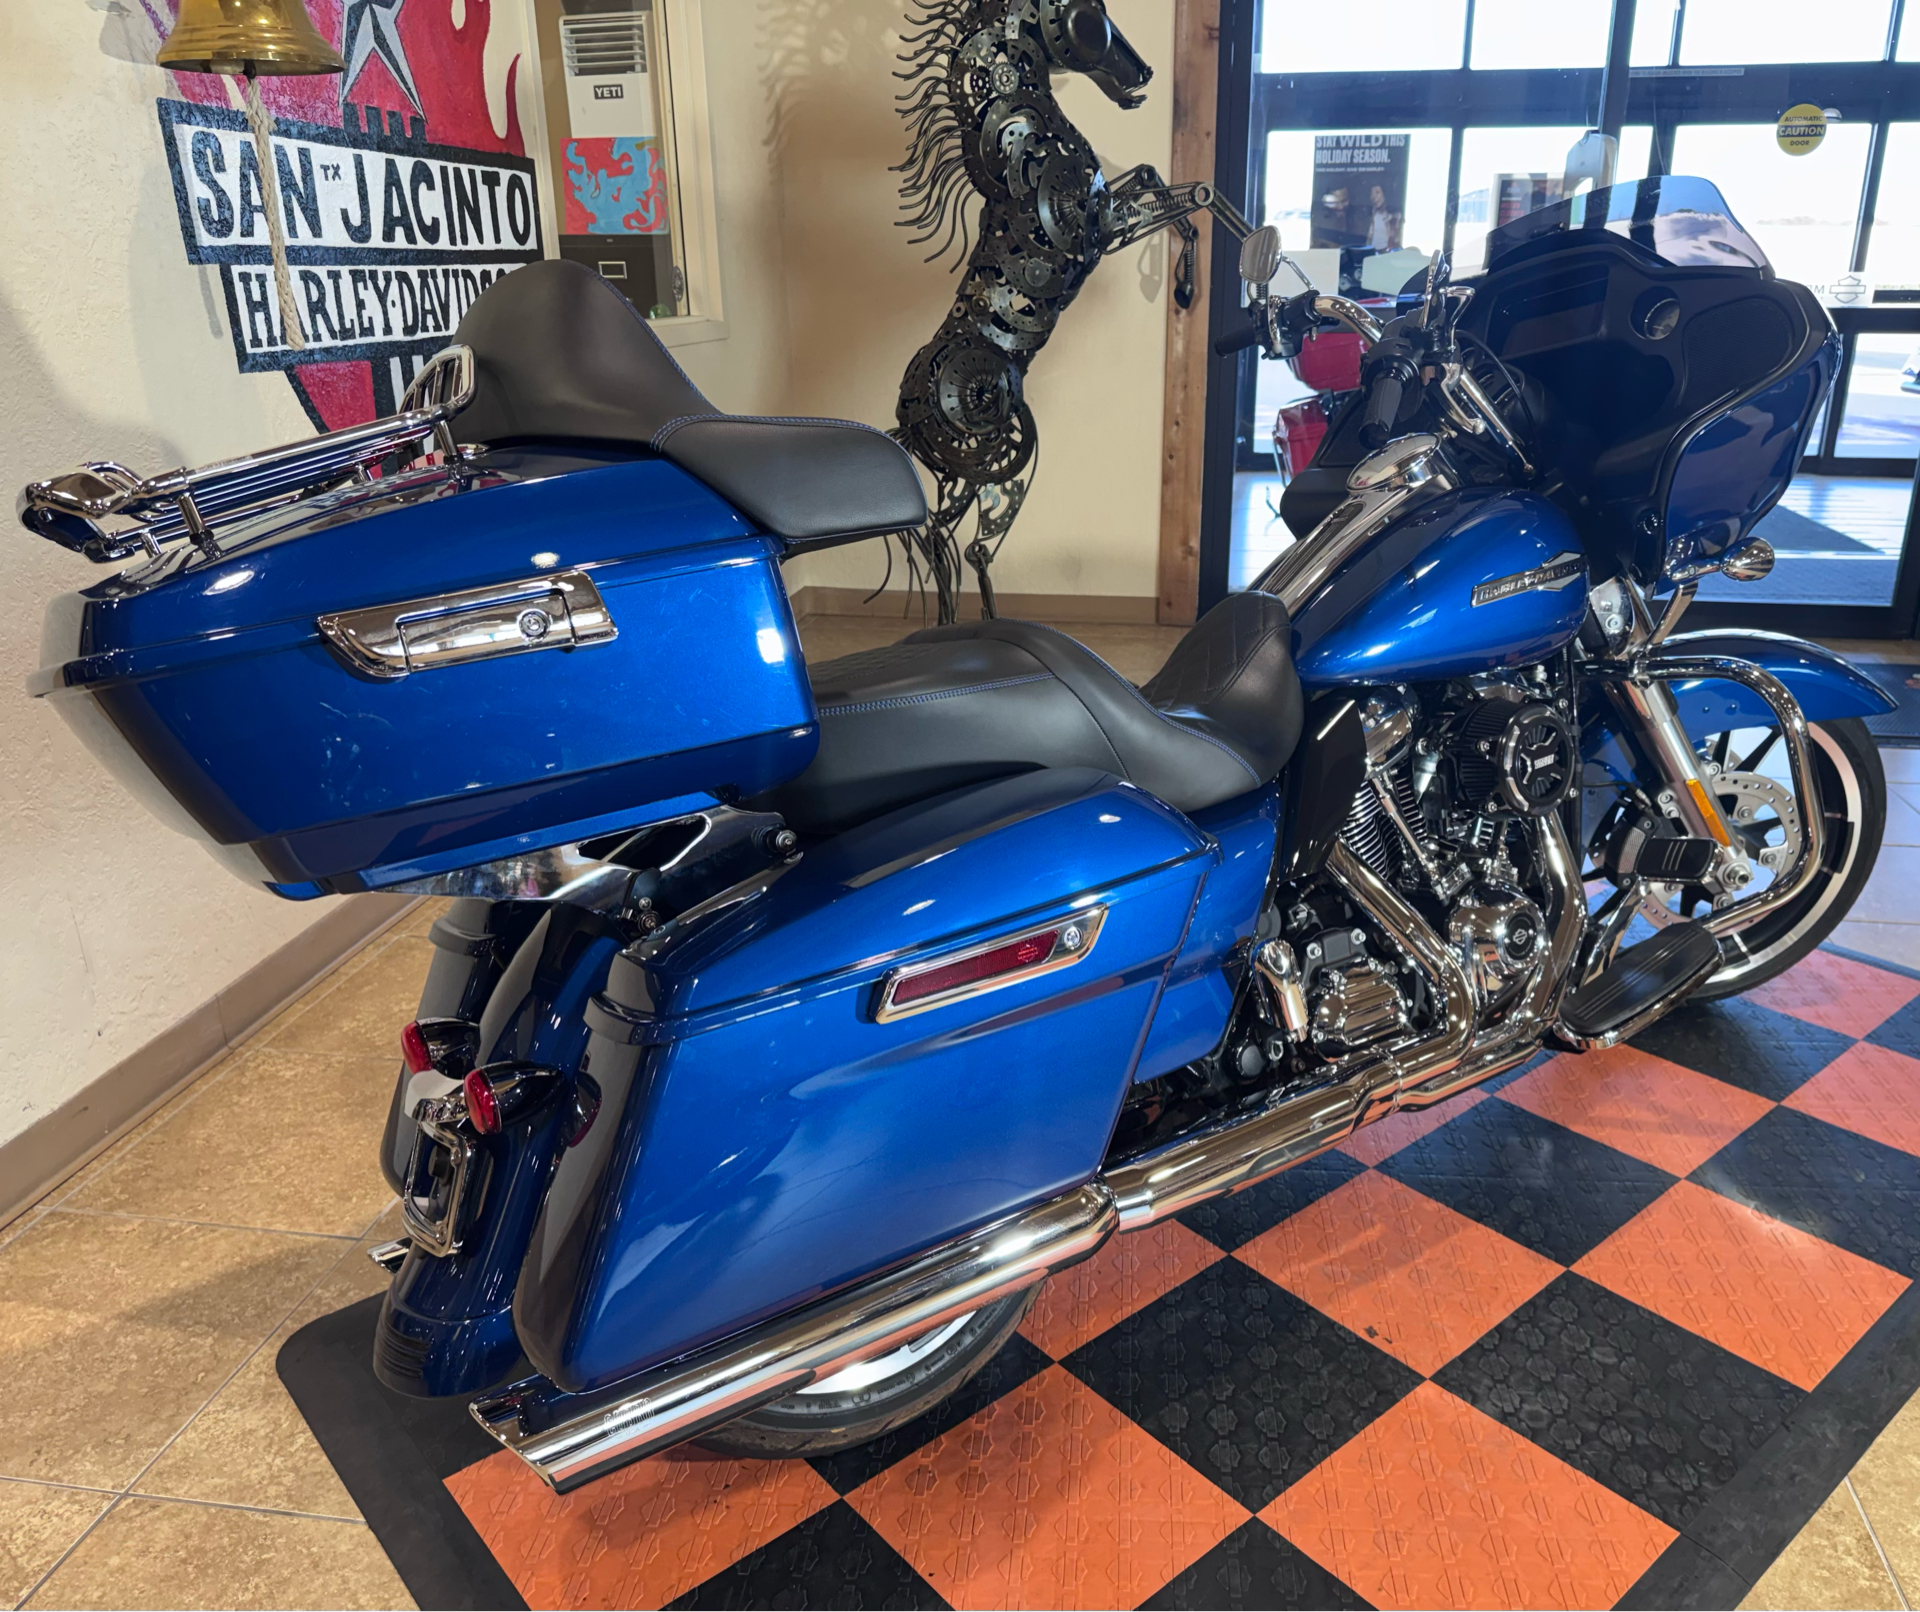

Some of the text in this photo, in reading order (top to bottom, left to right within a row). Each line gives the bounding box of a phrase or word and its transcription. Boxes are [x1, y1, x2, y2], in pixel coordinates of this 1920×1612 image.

[595, 86, 622, 98] YETI
[1784, 115, 1823, 123] AUTOMATIC
[1778, 125, 1825, 136] CAUTION
[1316, 133, 1406, 148] STAY WILD THIS
[1315, 148, 1391, 164] HOLIDAY SEASON.
[319, 163, 341, 181] TX
[191, 130, 531, 246] SAN JACINTO
